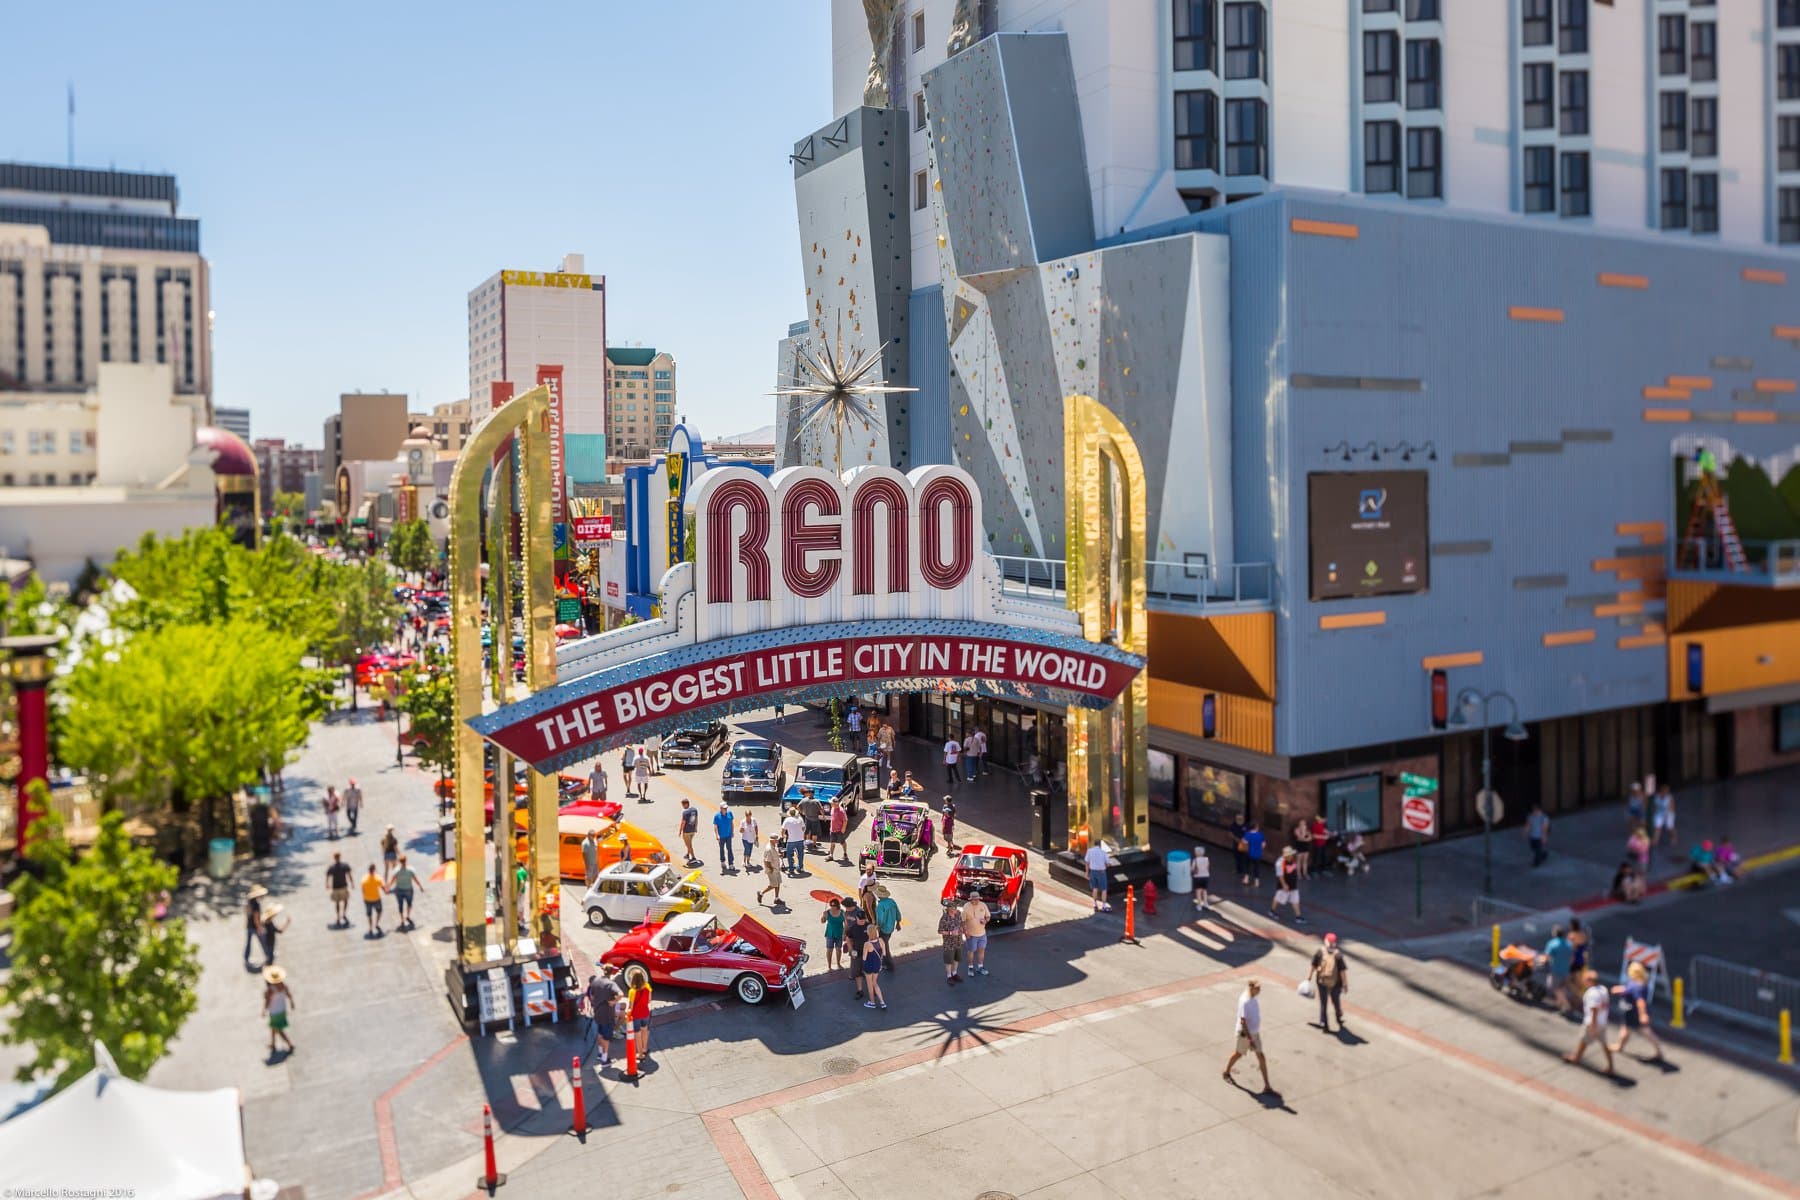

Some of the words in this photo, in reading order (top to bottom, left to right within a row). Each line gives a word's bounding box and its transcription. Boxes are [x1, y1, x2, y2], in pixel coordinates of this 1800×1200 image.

[503, 270, 541, 286] CAL
[543, 272, 592, 289] NEVA
[577, 523, 611, 534] GIFTS
[707, 476, 974, 604] RENO
[535, 701, 606, 751] THE
[613, 661, 746, 724] BIGGEST
[757, 647, 843, 688] LITTLE
[853, 643, 914, 673] CITY
[919, 642, 951, 671] IN
[958, 643, 1007, 674] THE
[1014, 648, 1107, 690] WORLD
[486, 1006, 507, 1016] ONLY
